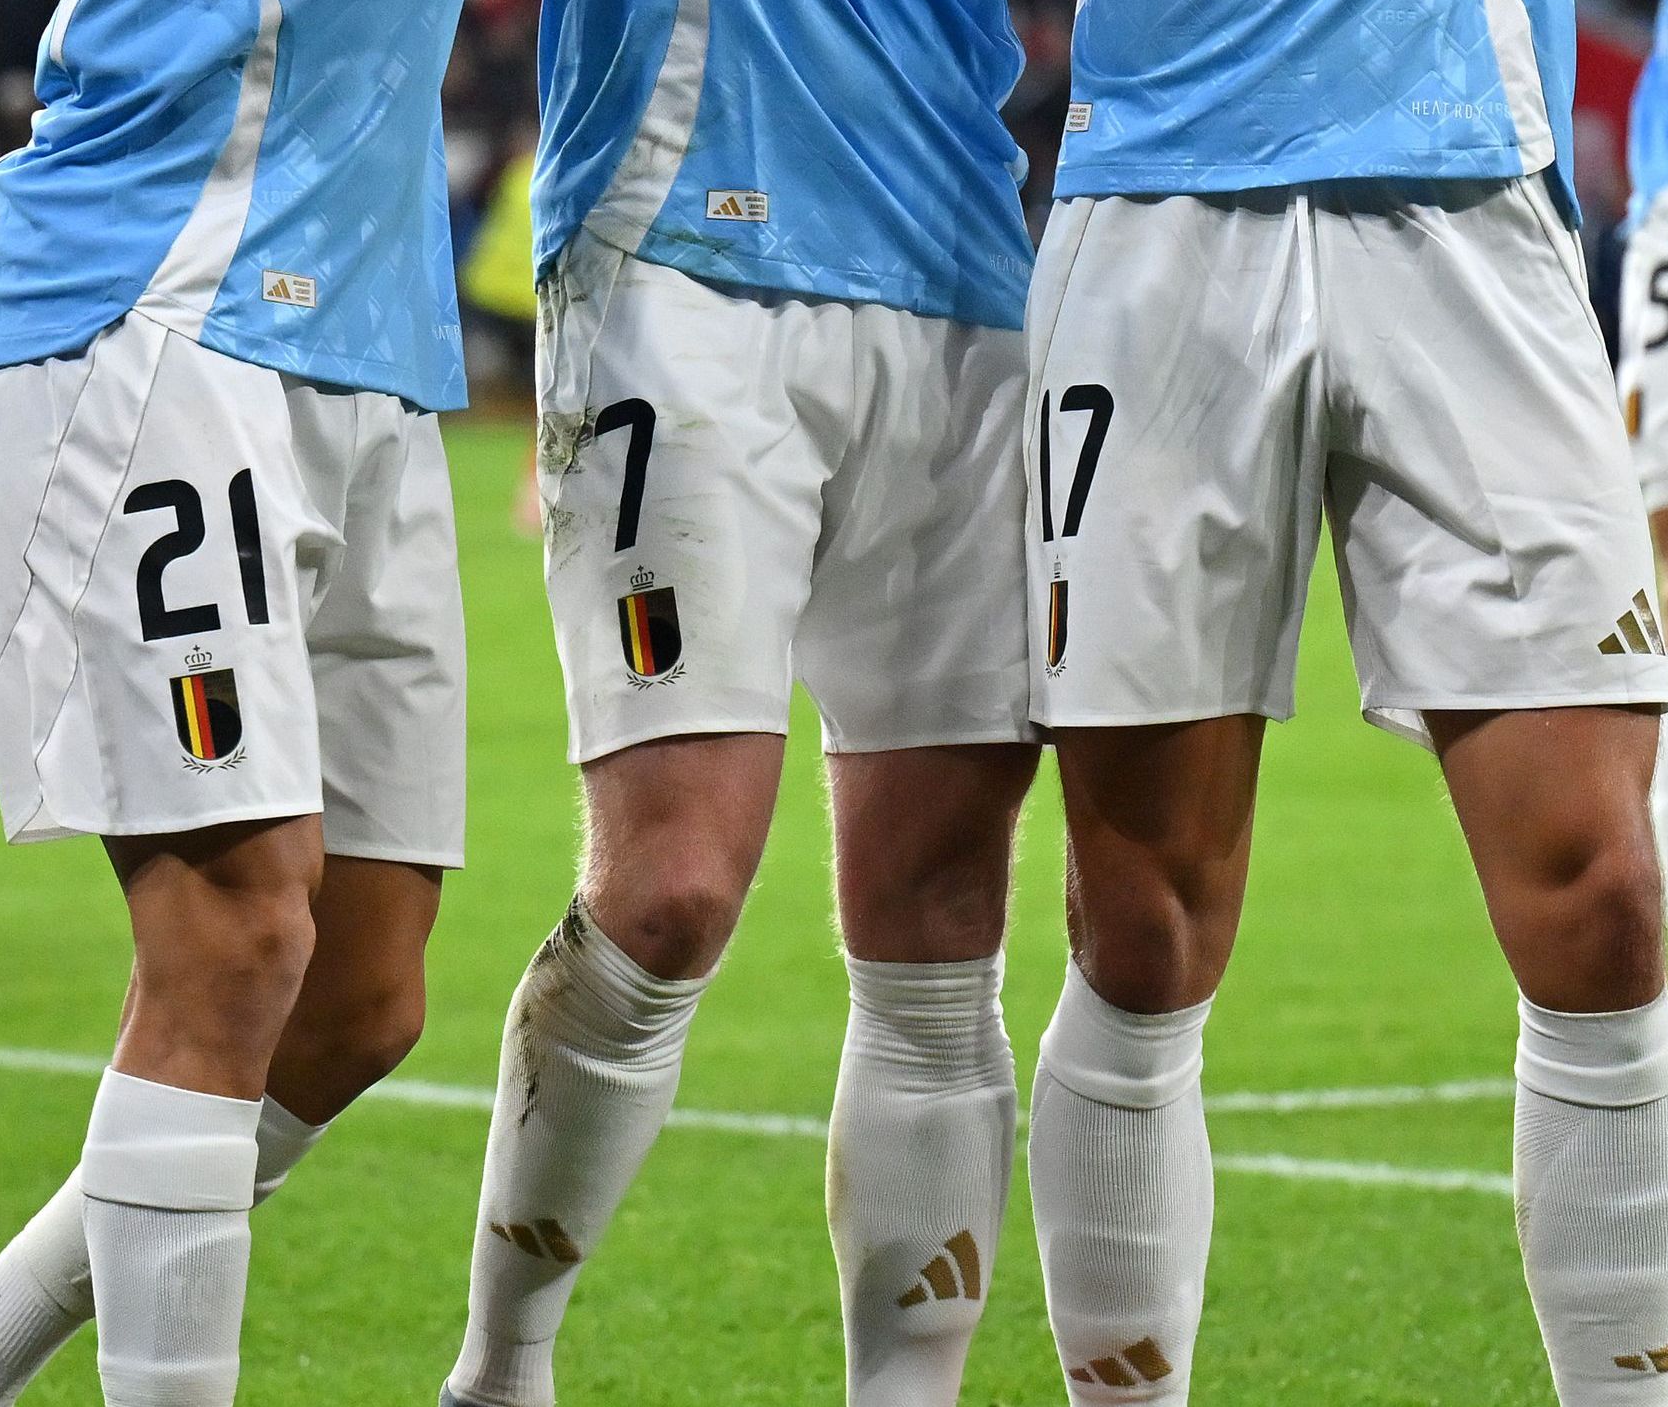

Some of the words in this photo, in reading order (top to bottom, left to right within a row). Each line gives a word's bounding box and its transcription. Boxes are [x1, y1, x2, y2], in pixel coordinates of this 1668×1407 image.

[593, 397, 656, 552] 7
[1039, 384, 1115, 542] 17
[123, 467, 270, 642] 21
